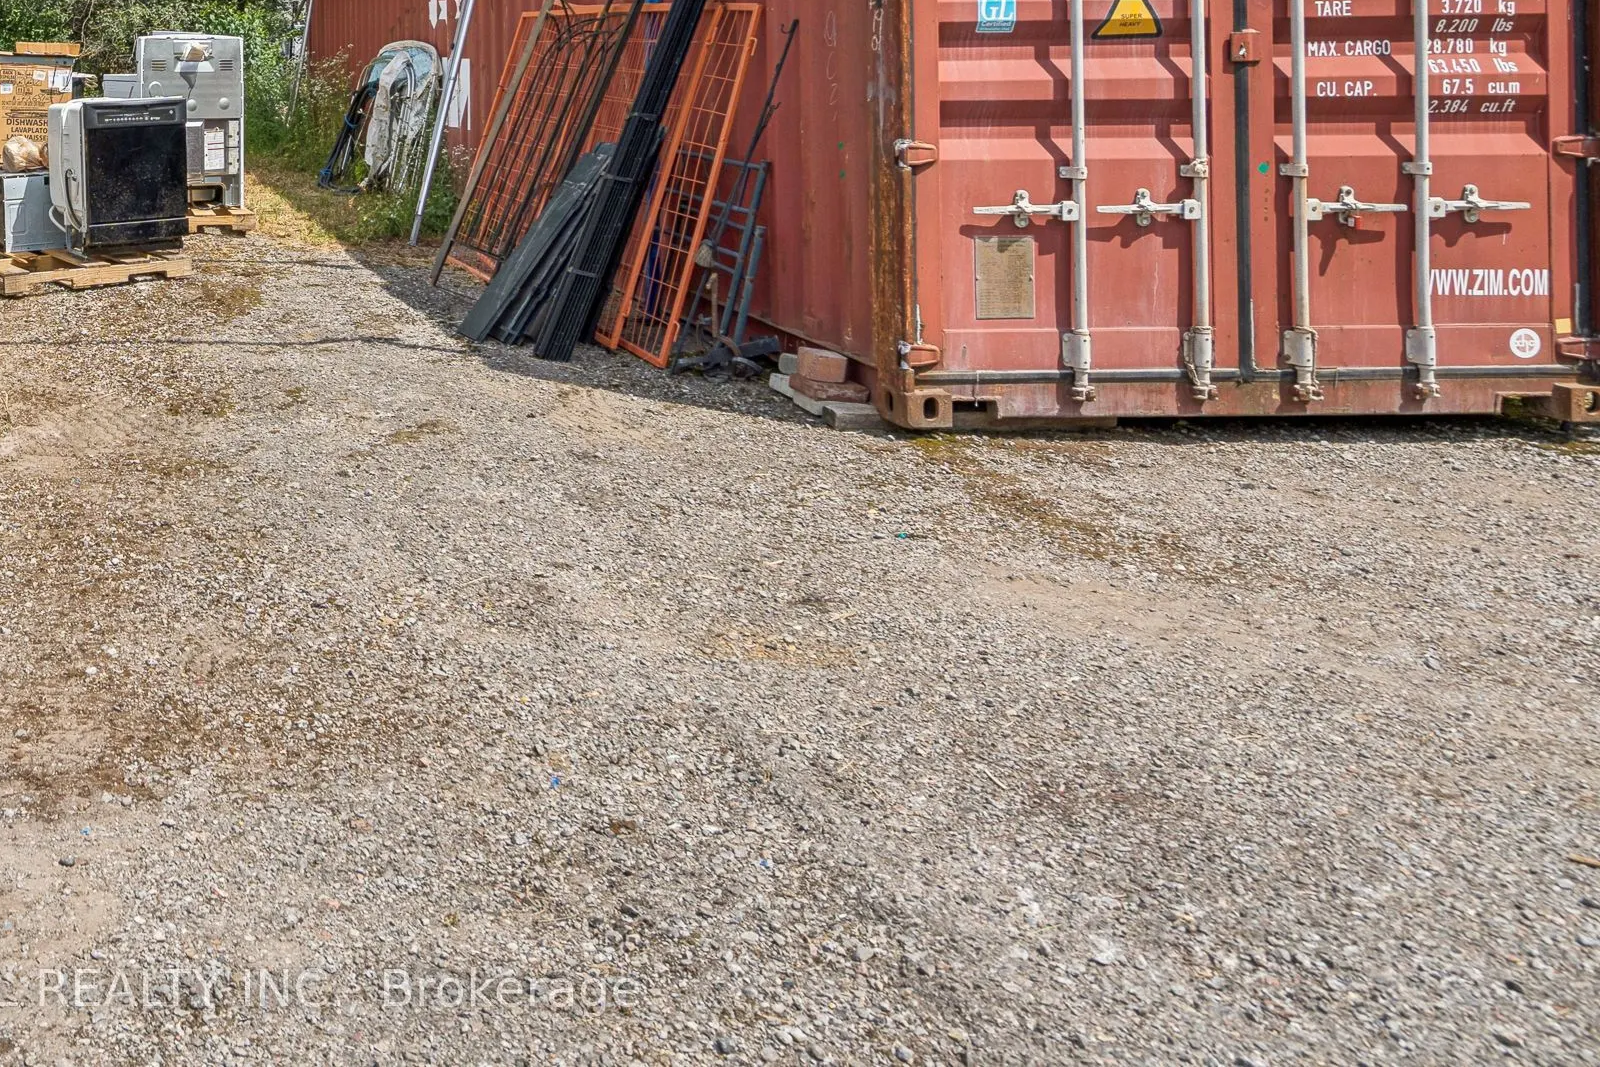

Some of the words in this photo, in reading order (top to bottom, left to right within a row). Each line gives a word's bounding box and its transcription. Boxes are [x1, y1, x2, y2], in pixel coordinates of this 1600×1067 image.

[1314, 0, 1353, 17] TARE
[1435, 18, 1480, 33] 8.200
[1491, 17, 1515, 33] lbs
[1307, 41, 1341, 58] MAX.
[1345, 40, 1392, 56] CARGO
[1489, 38, 1507, 57] kg
[1428, 59, 1482, 74] 63.450
[1493, 58, 1519, 73] lbs
[1316, 81, 1340, 97] CU.
[1344, 81, 1378, 97] CAP.
[1442, 79, 1475, 95] 67.5
[1487, 81, 1521, 95] cu.m
[1479, 98, 1517, 114] cu.ft
[6, 118, 48, 127] DISHWASH
